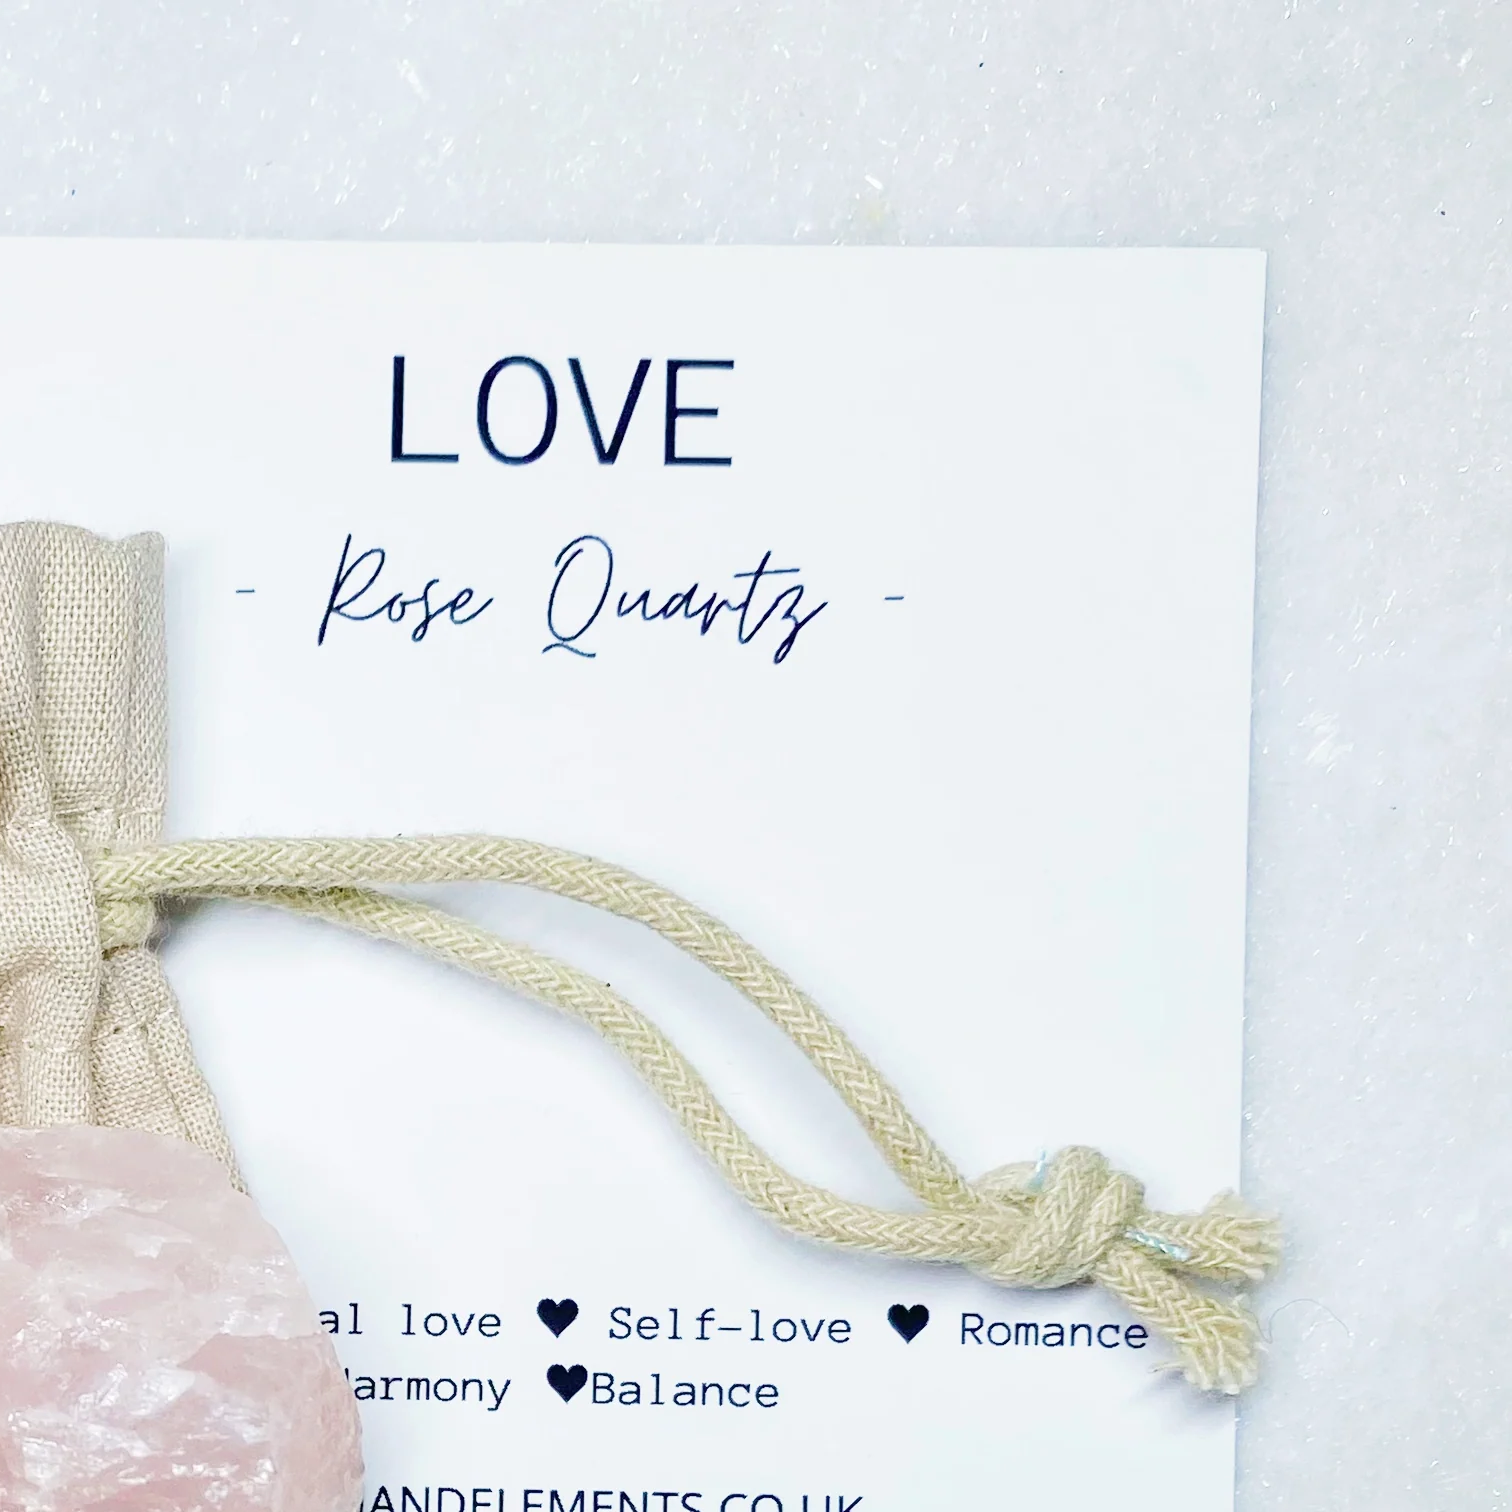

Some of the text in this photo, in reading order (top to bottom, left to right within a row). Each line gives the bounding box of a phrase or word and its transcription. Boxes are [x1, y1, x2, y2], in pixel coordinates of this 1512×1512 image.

[390, 354, 735, 467] LOVE
[317, 533, 494, 646] Rose
[541, 535, 829, 665] Quartz
[400, 1303, 502, 1338] love
[608, 1306, 853, 1344] Self-love
[960, 1312, 1149, 1349] Romance
[344, 1367, 780, 1412] armony Balance
